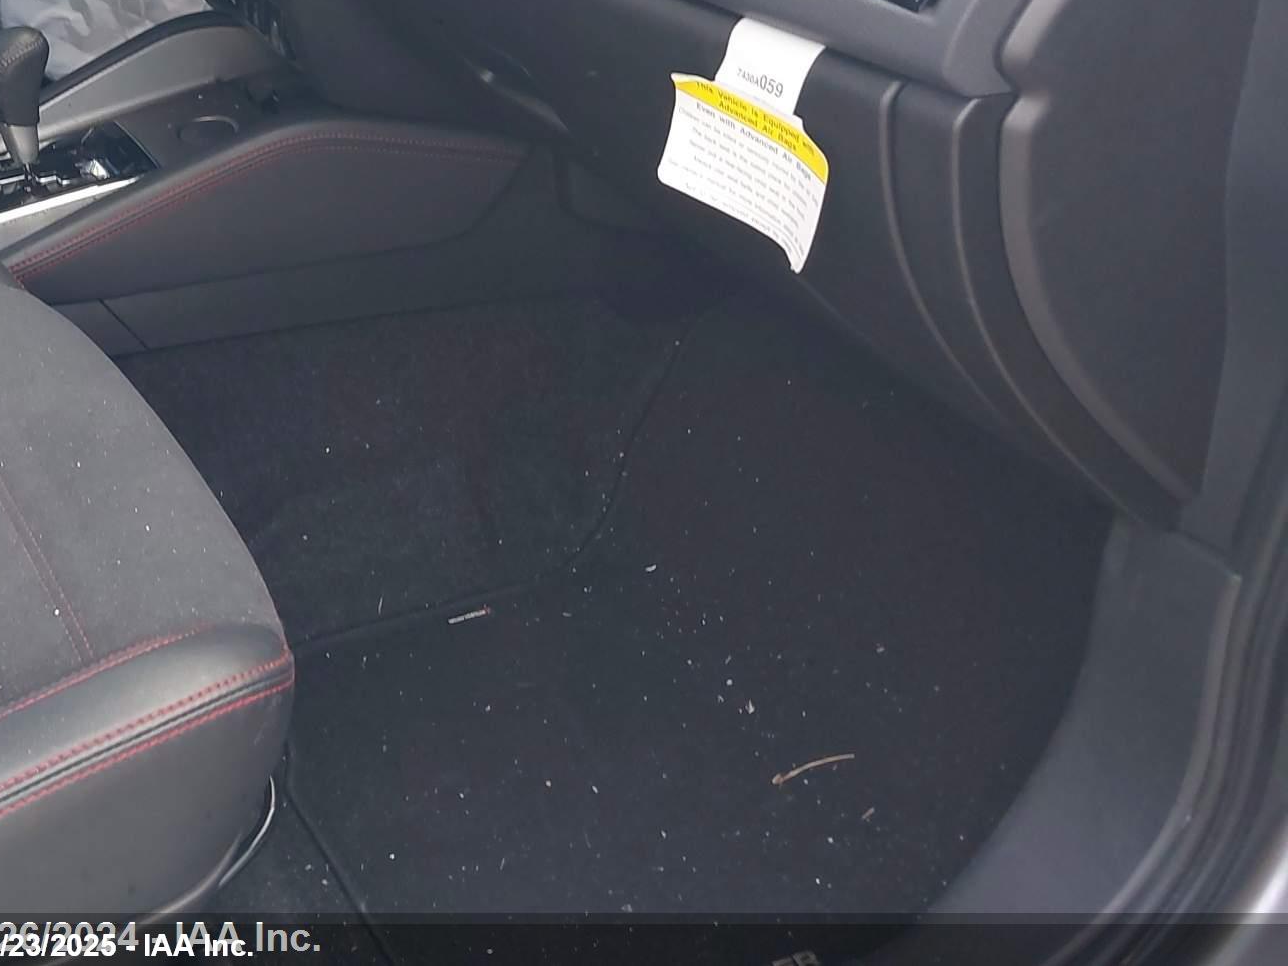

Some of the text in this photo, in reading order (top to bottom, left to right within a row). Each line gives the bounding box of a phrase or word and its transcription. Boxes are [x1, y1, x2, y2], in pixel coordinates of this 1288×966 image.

[696, 102, 716, 119] Even
[718, 113, 736, 130] with
[740, 125, 779, 155] Advanced
[718, 89, 749, 110] Vehicle
[763, 112, 800, 141] Equipped
[719, 101, 758, 128] Advanced
[777, 134, 797, 152] Bags
